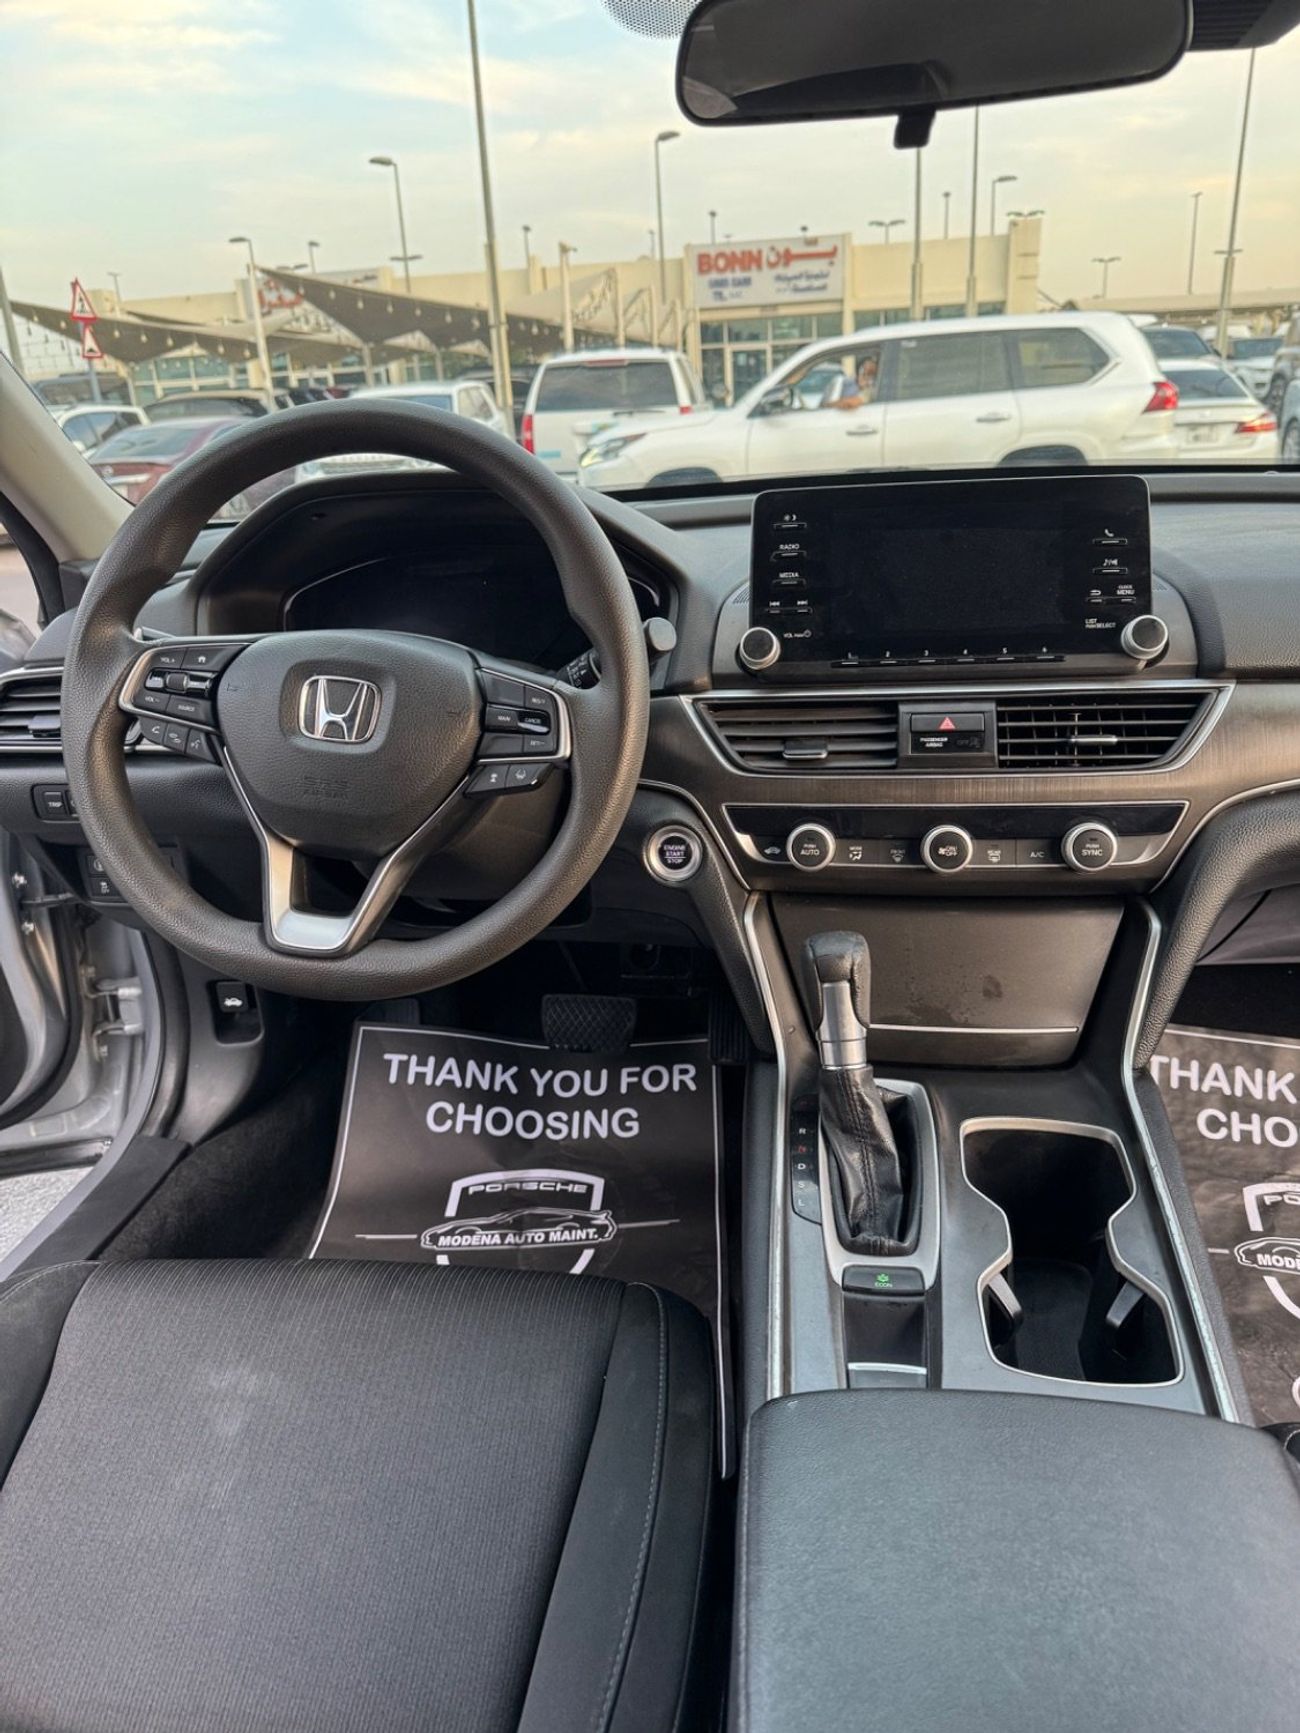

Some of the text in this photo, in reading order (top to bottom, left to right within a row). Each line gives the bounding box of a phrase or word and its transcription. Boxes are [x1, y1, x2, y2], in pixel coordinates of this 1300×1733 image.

[697, 249, 762, 275] BONN
[1081, 849, 1103, 857] SYNC
[383, 1052, 697, 1098] THANK YOU FOR
[1149, 1054, 1298, 1105] THANK
[425, 1100, 640, 1141] CHOOSING
[468, 1181, 589, 1195] PORSCHE
[437, 1228, 599, 1247] MODENA AUTO MAINT.
